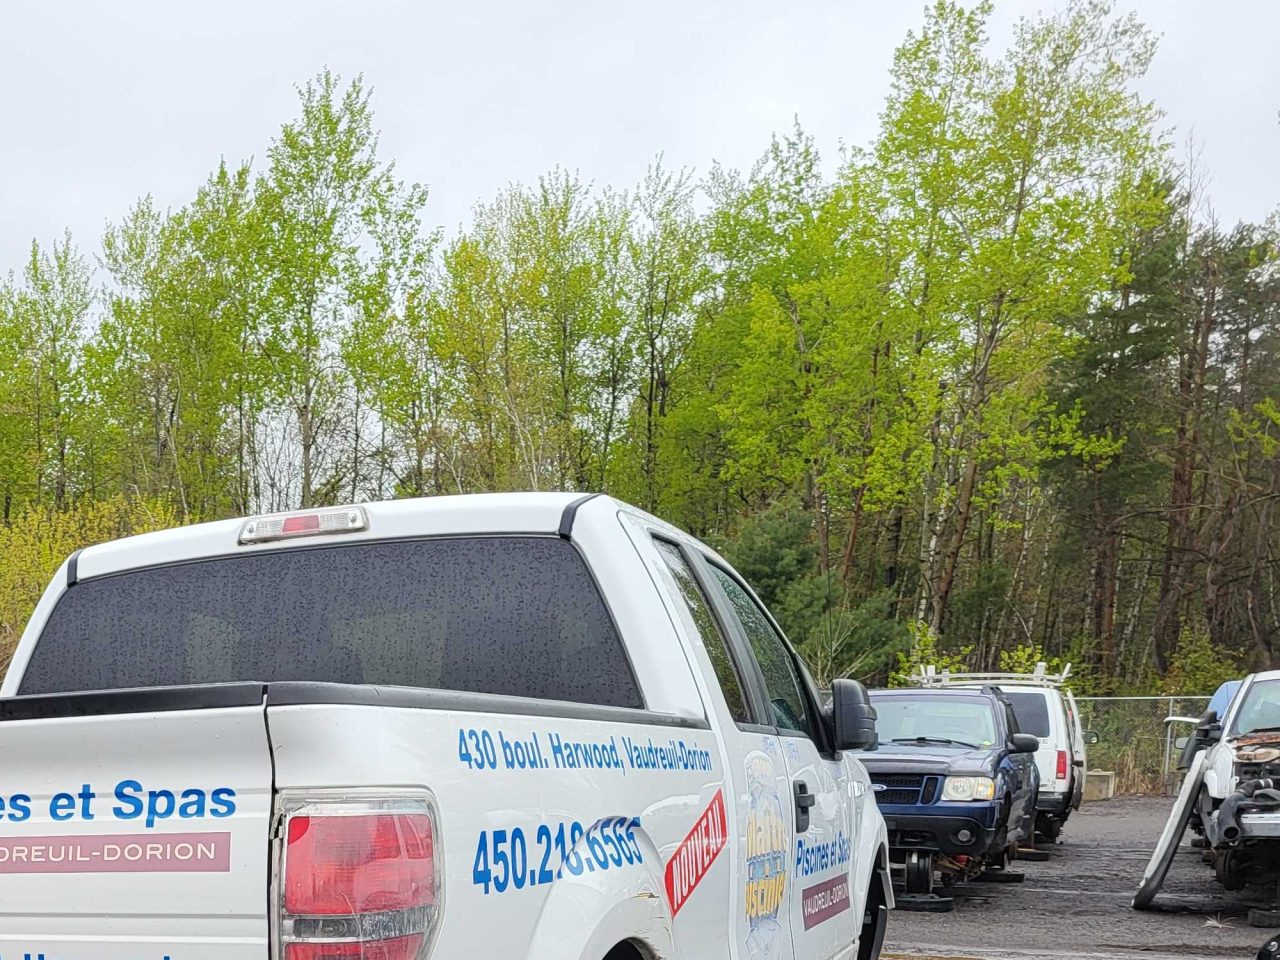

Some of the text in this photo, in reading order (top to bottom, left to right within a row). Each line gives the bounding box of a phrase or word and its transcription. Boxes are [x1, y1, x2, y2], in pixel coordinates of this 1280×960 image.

[458, 728, 497, 770] 430
[498, 731, 549, 769] boul.
[548, 732, 626, 777] Harwood,
[621, 736, 712, 771] Vaudreuil-Dorion
[49, 784, 96, 821] et
[113, 780, 237, 828] Spas
[672, 799, 723, 910] NOUVEAU
[795, 836, 829, 878] Piscines
[830, 840, 838, 868] et
[803, 883, 850, 917] VAUDREUIL-DORION
